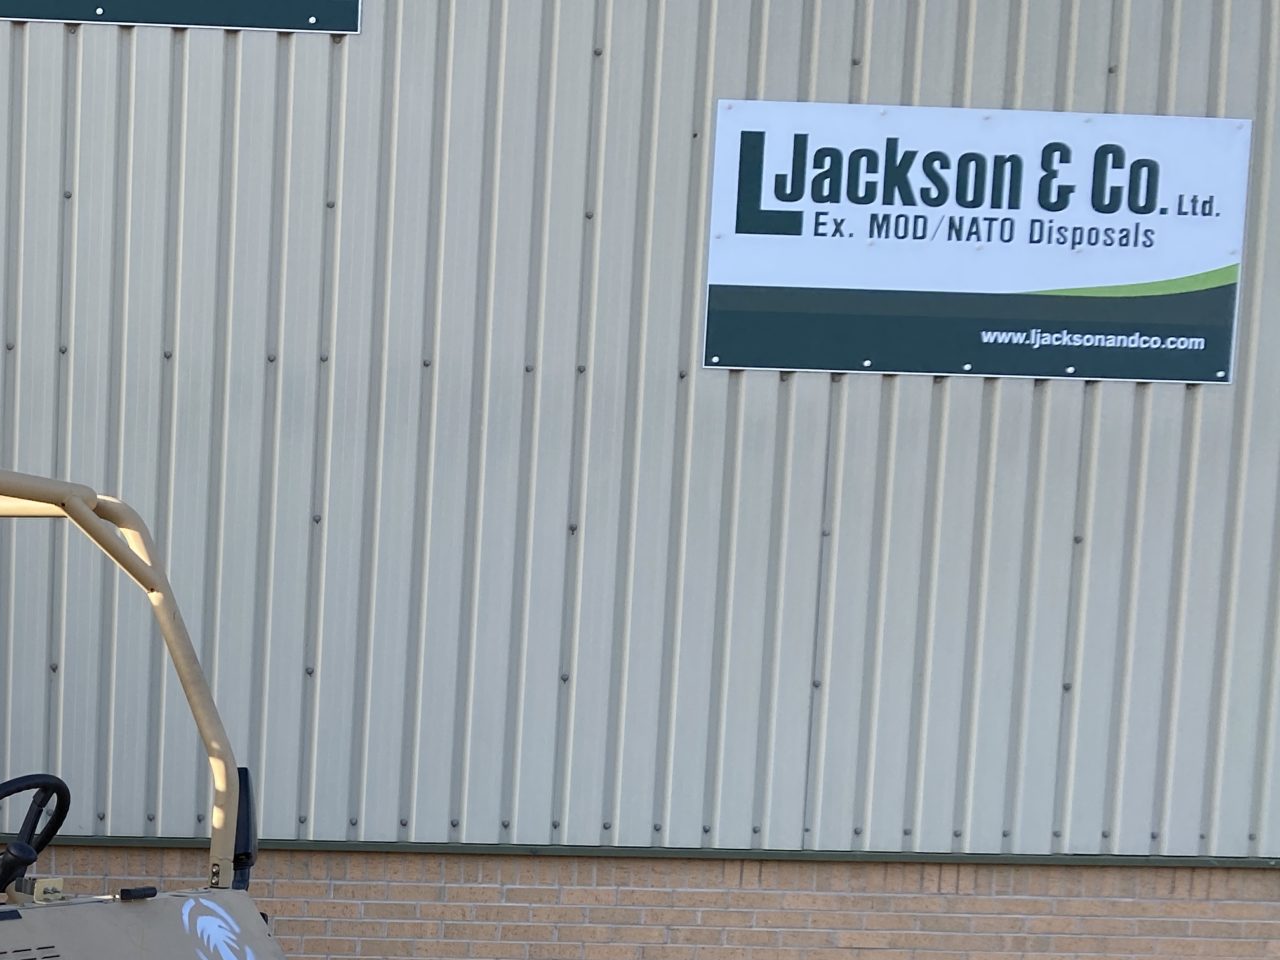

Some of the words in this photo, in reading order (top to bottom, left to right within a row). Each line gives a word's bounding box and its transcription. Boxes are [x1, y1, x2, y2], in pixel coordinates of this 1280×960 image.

[1038, 142, 1076, 212] &
[1091, 144, 1169, 215] Co.
[1177, 194, 1220, 217] Ltd.
[814, 211, 854, 238] Ex.
[869, 213, 1015, 243] MOD/NATO
[1029, 219, 1155, 250] Disposals
[981, 329, 1206, 350] www.ljacksonandco.com
